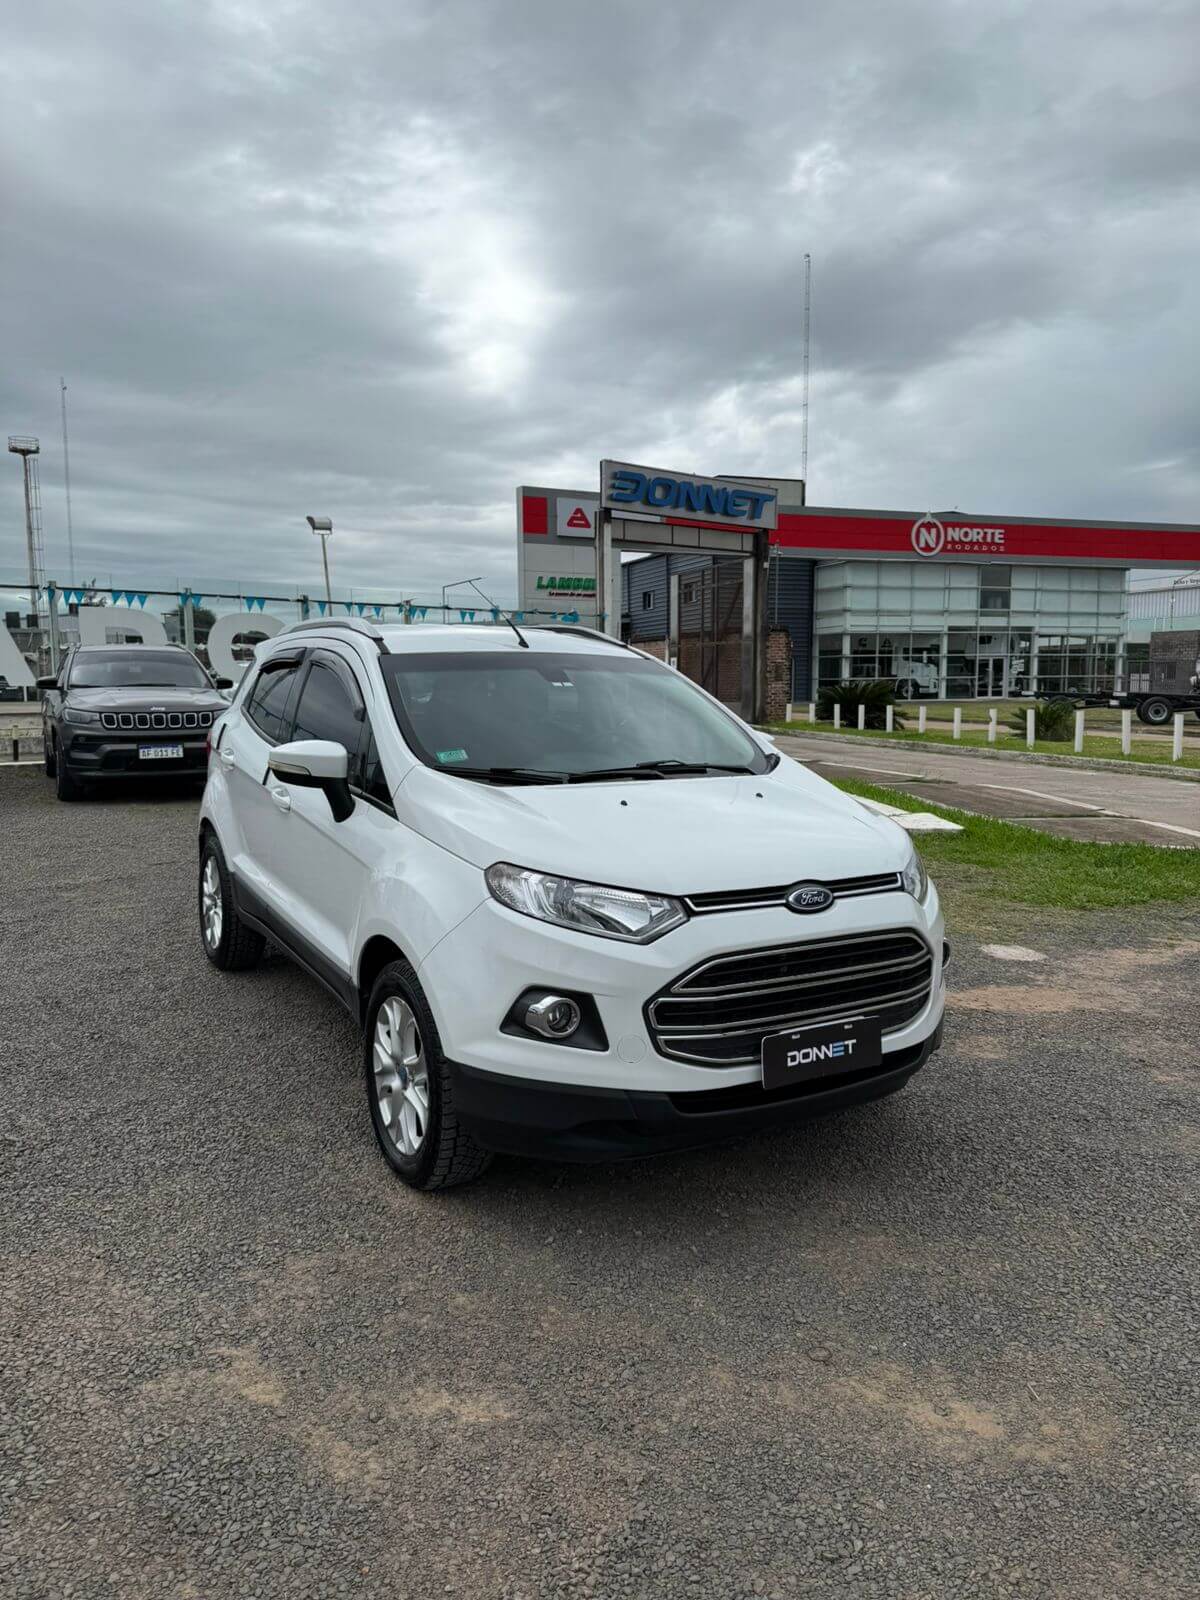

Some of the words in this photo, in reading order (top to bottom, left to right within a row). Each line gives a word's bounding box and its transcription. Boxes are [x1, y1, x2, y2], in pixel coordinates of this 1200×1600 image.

[611, 470, 775, 519] DONNET
[946, 527, 1005, 543] NORTE
[946, 543, 1005, 552] RODADOS
[799, 889, 825, 905] Ford
[786, 1039, 857, 1067] DONNET
